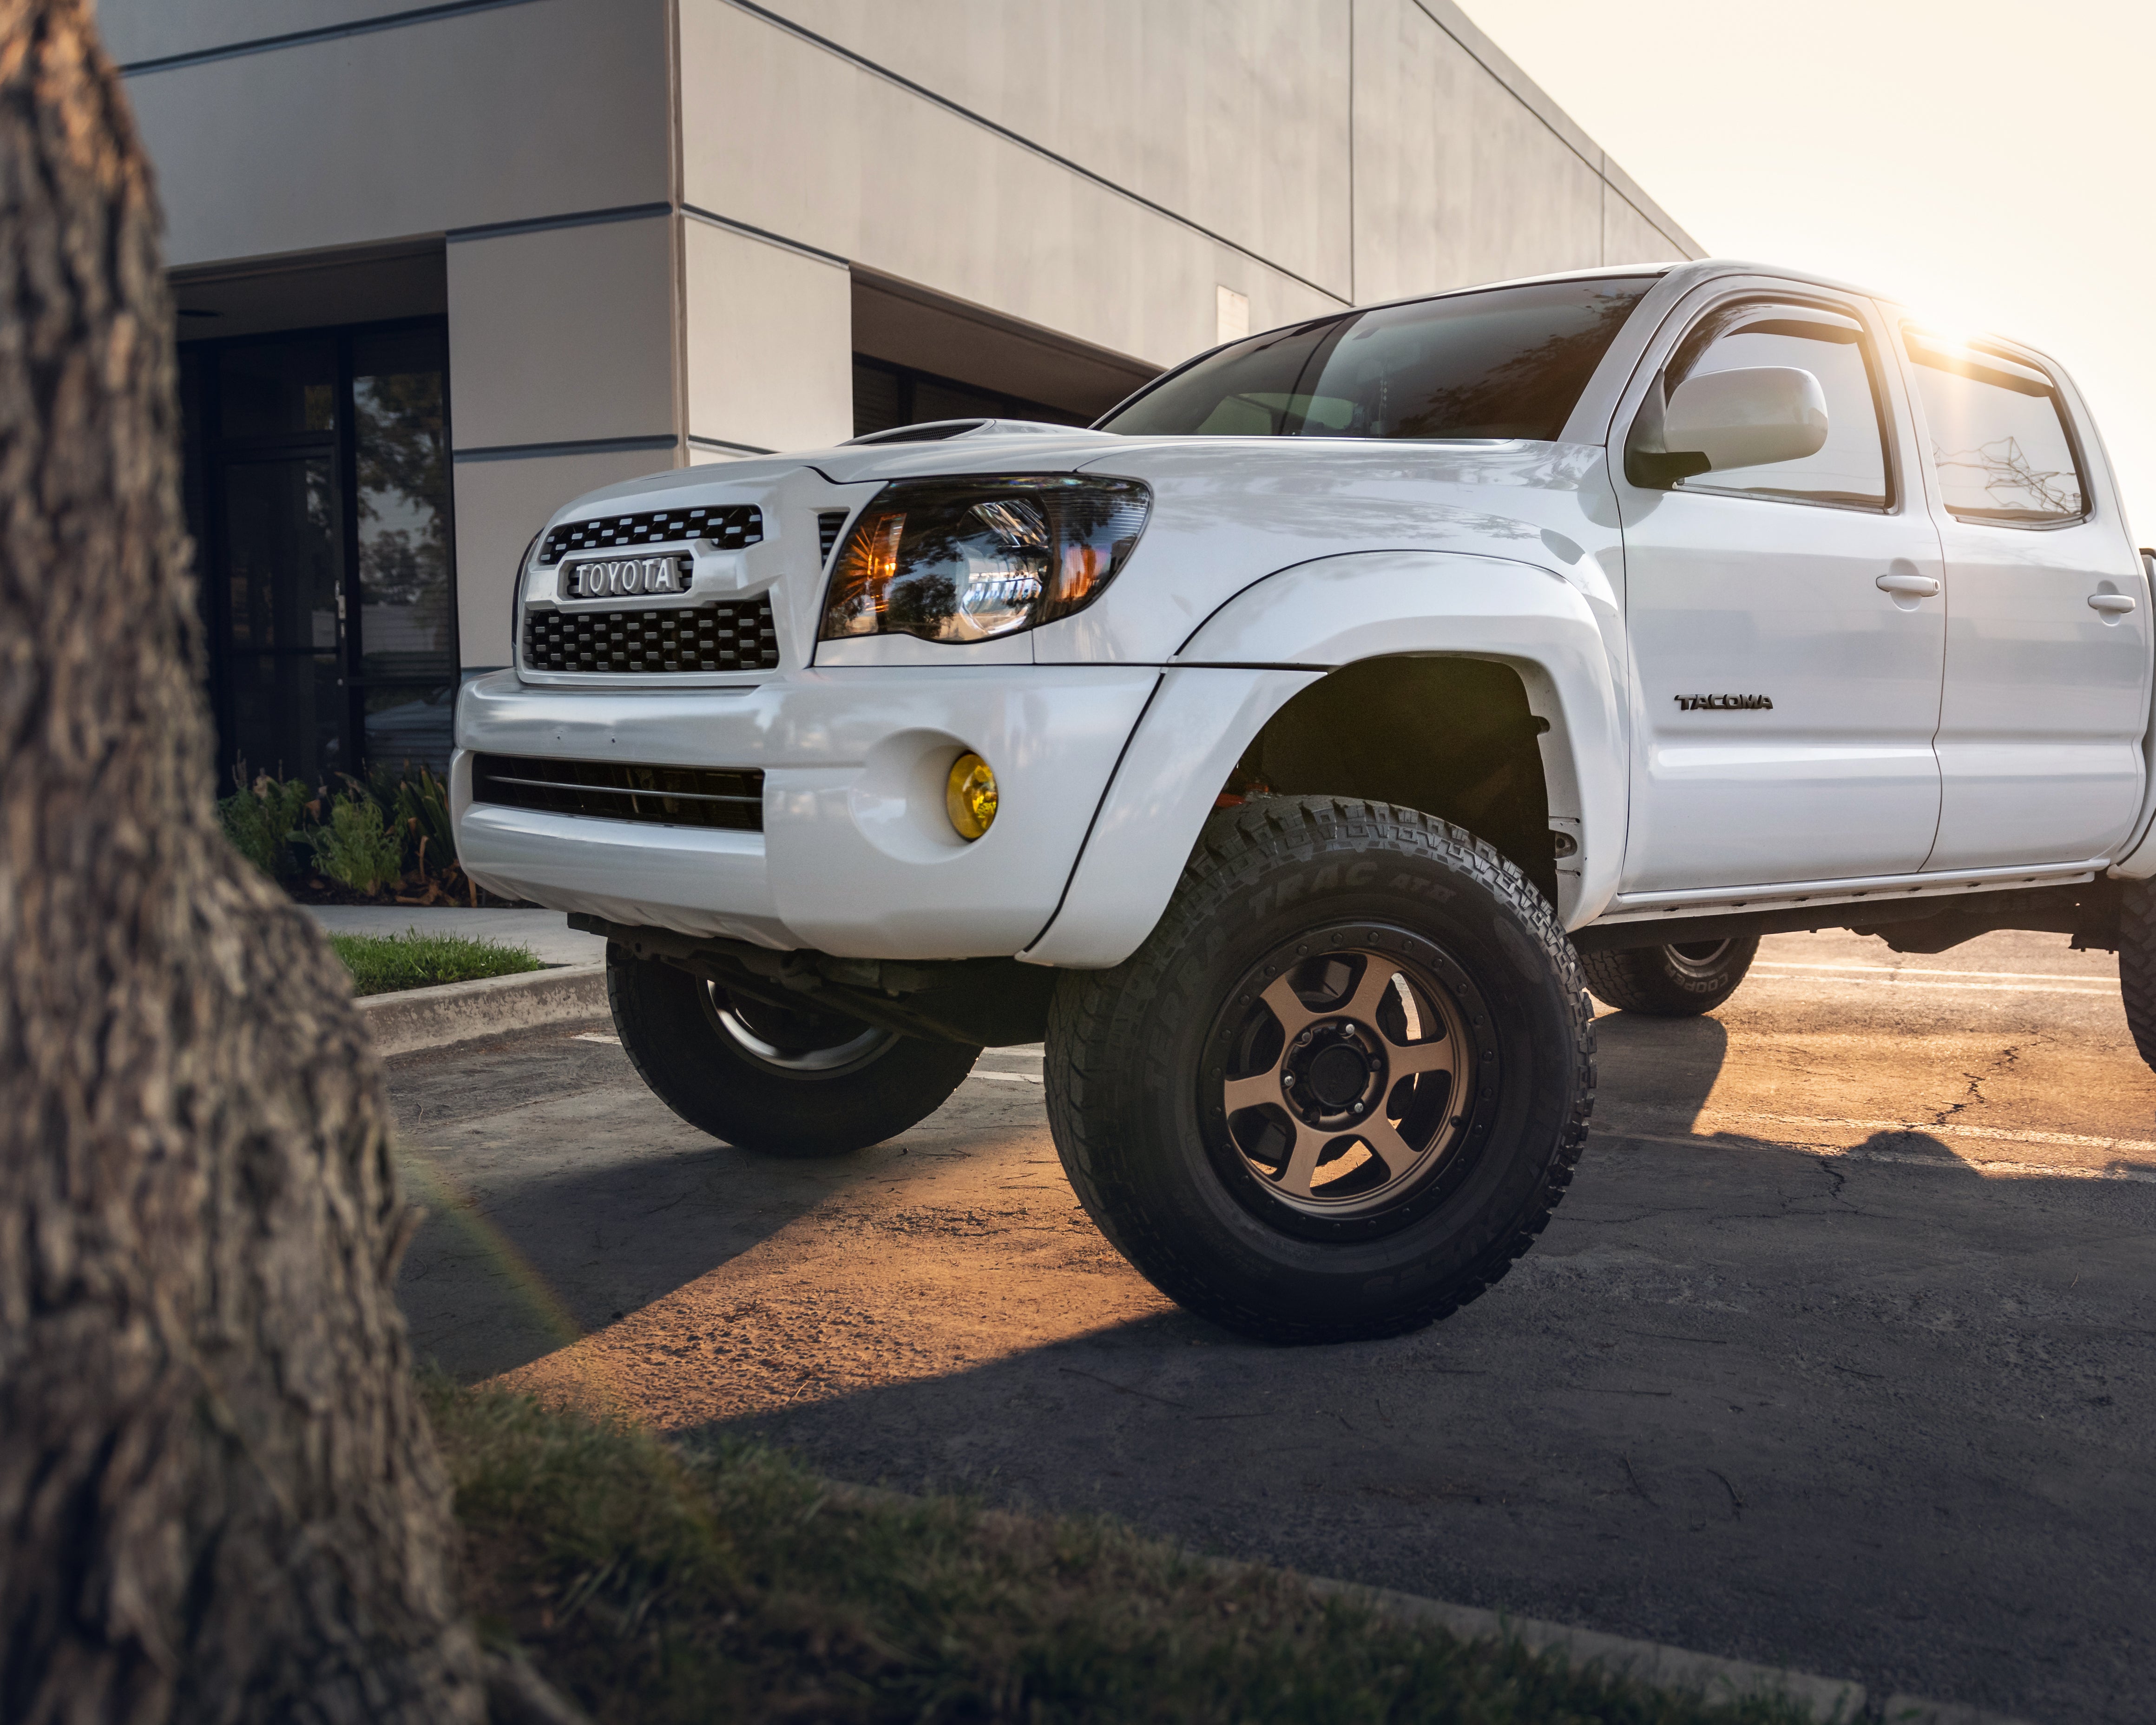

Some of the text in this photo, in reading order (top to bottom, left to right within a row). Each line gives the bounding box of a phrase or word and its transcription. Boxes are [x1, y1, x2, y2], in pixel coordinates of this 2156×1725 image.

[576, 557, 684, 597] TOYOTA
[1674, 694, 1774, 710] TACOMA
[1249, 861, 1378, 920] TRAC
[1664, 962, 1729, 993] COOPER
